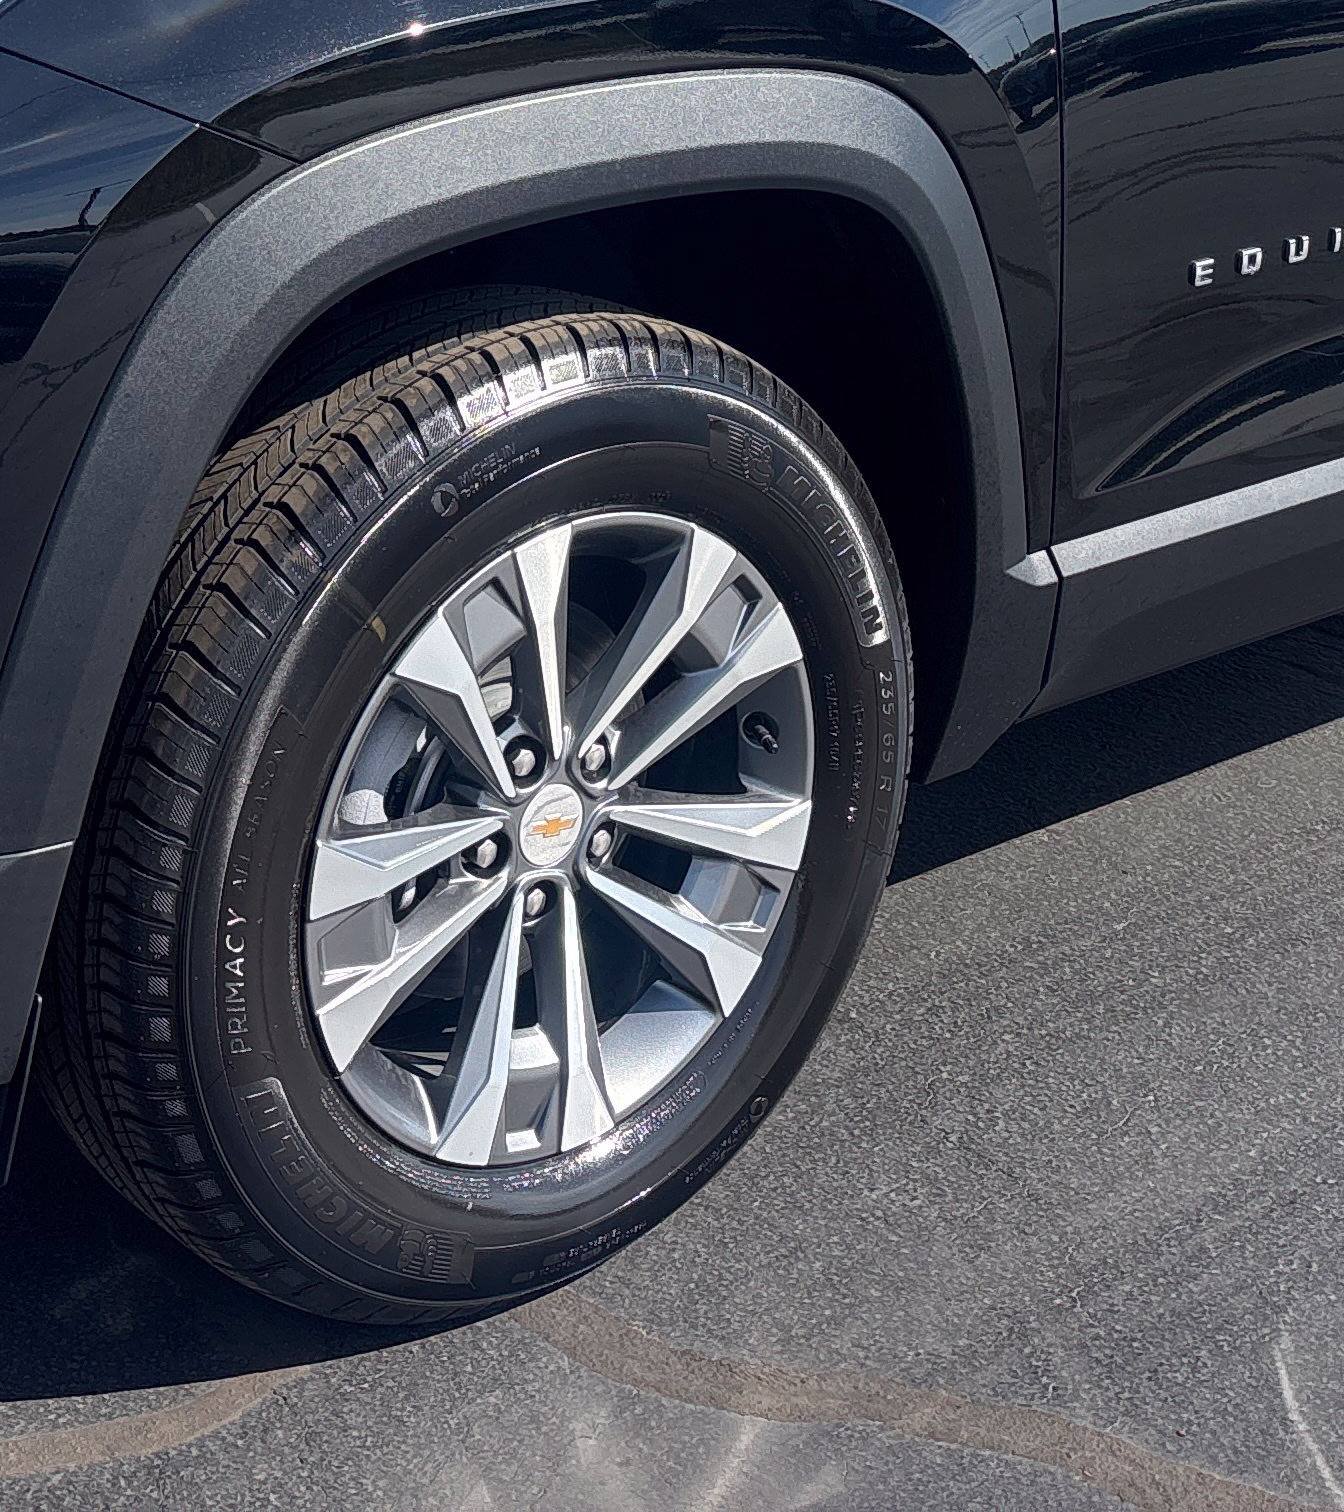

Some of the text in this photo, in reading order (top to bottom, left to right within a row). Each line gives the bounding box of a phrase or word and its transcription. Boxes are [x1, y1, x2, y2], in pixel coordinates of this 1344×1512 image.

[459, 443, 517, 487] MICHELIN
[775, 464, 886, 637] MICHELIN
[224, 906, 253, 1057] PRIMACY
[239, 1088, 395, 1256] MICHELIN
